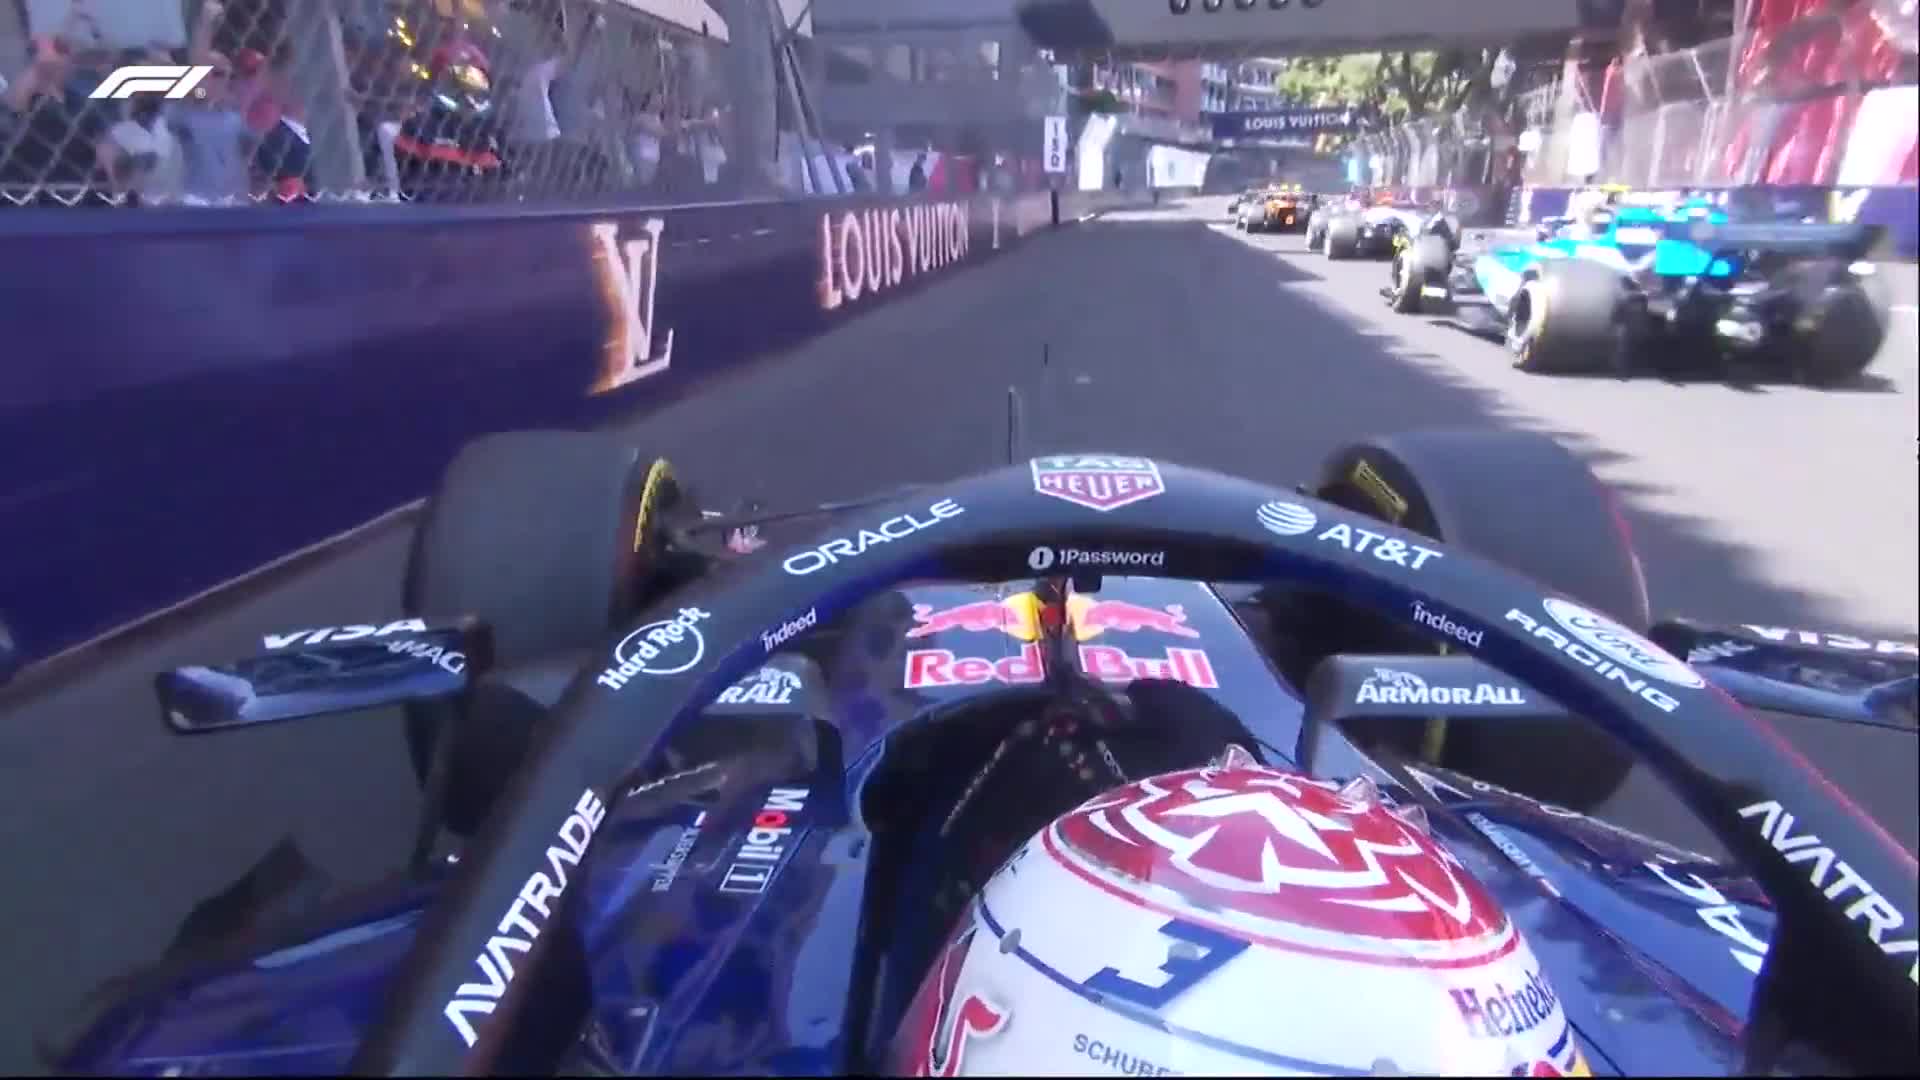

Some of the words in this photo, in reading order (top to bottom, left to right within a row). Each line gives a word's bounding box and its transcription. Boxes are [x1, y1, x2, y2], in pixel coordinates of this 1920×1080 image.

[1245, 117, 1285, 130] LOUIS
[822, 207, 903, 309] LOUIS
[906, 200, 969, 276] VUITTON
[1040, 475, 1153, 500] HEUER
[783, 499, 965, 575] ORACLE
[1060, 549, 1165, 567] 1Password
[1318, 523, 1444, 570] AT&T
[263, 618, 427, 649] VISA
[761, 608, 817, 652] indeed
[1410, 600, 1484, 648] indeed
[597, 638, 661, 691] Hard
[646, 607, 711, 647] Rock
[904, 642, 1045, 688] Red
[1078, 644, 1220, 688] Bull
[1505, 608, 1680, 713] RACING
[737, 788, 811, 861] Mobil
[444, 788, 607, 1048] AVATRADE
